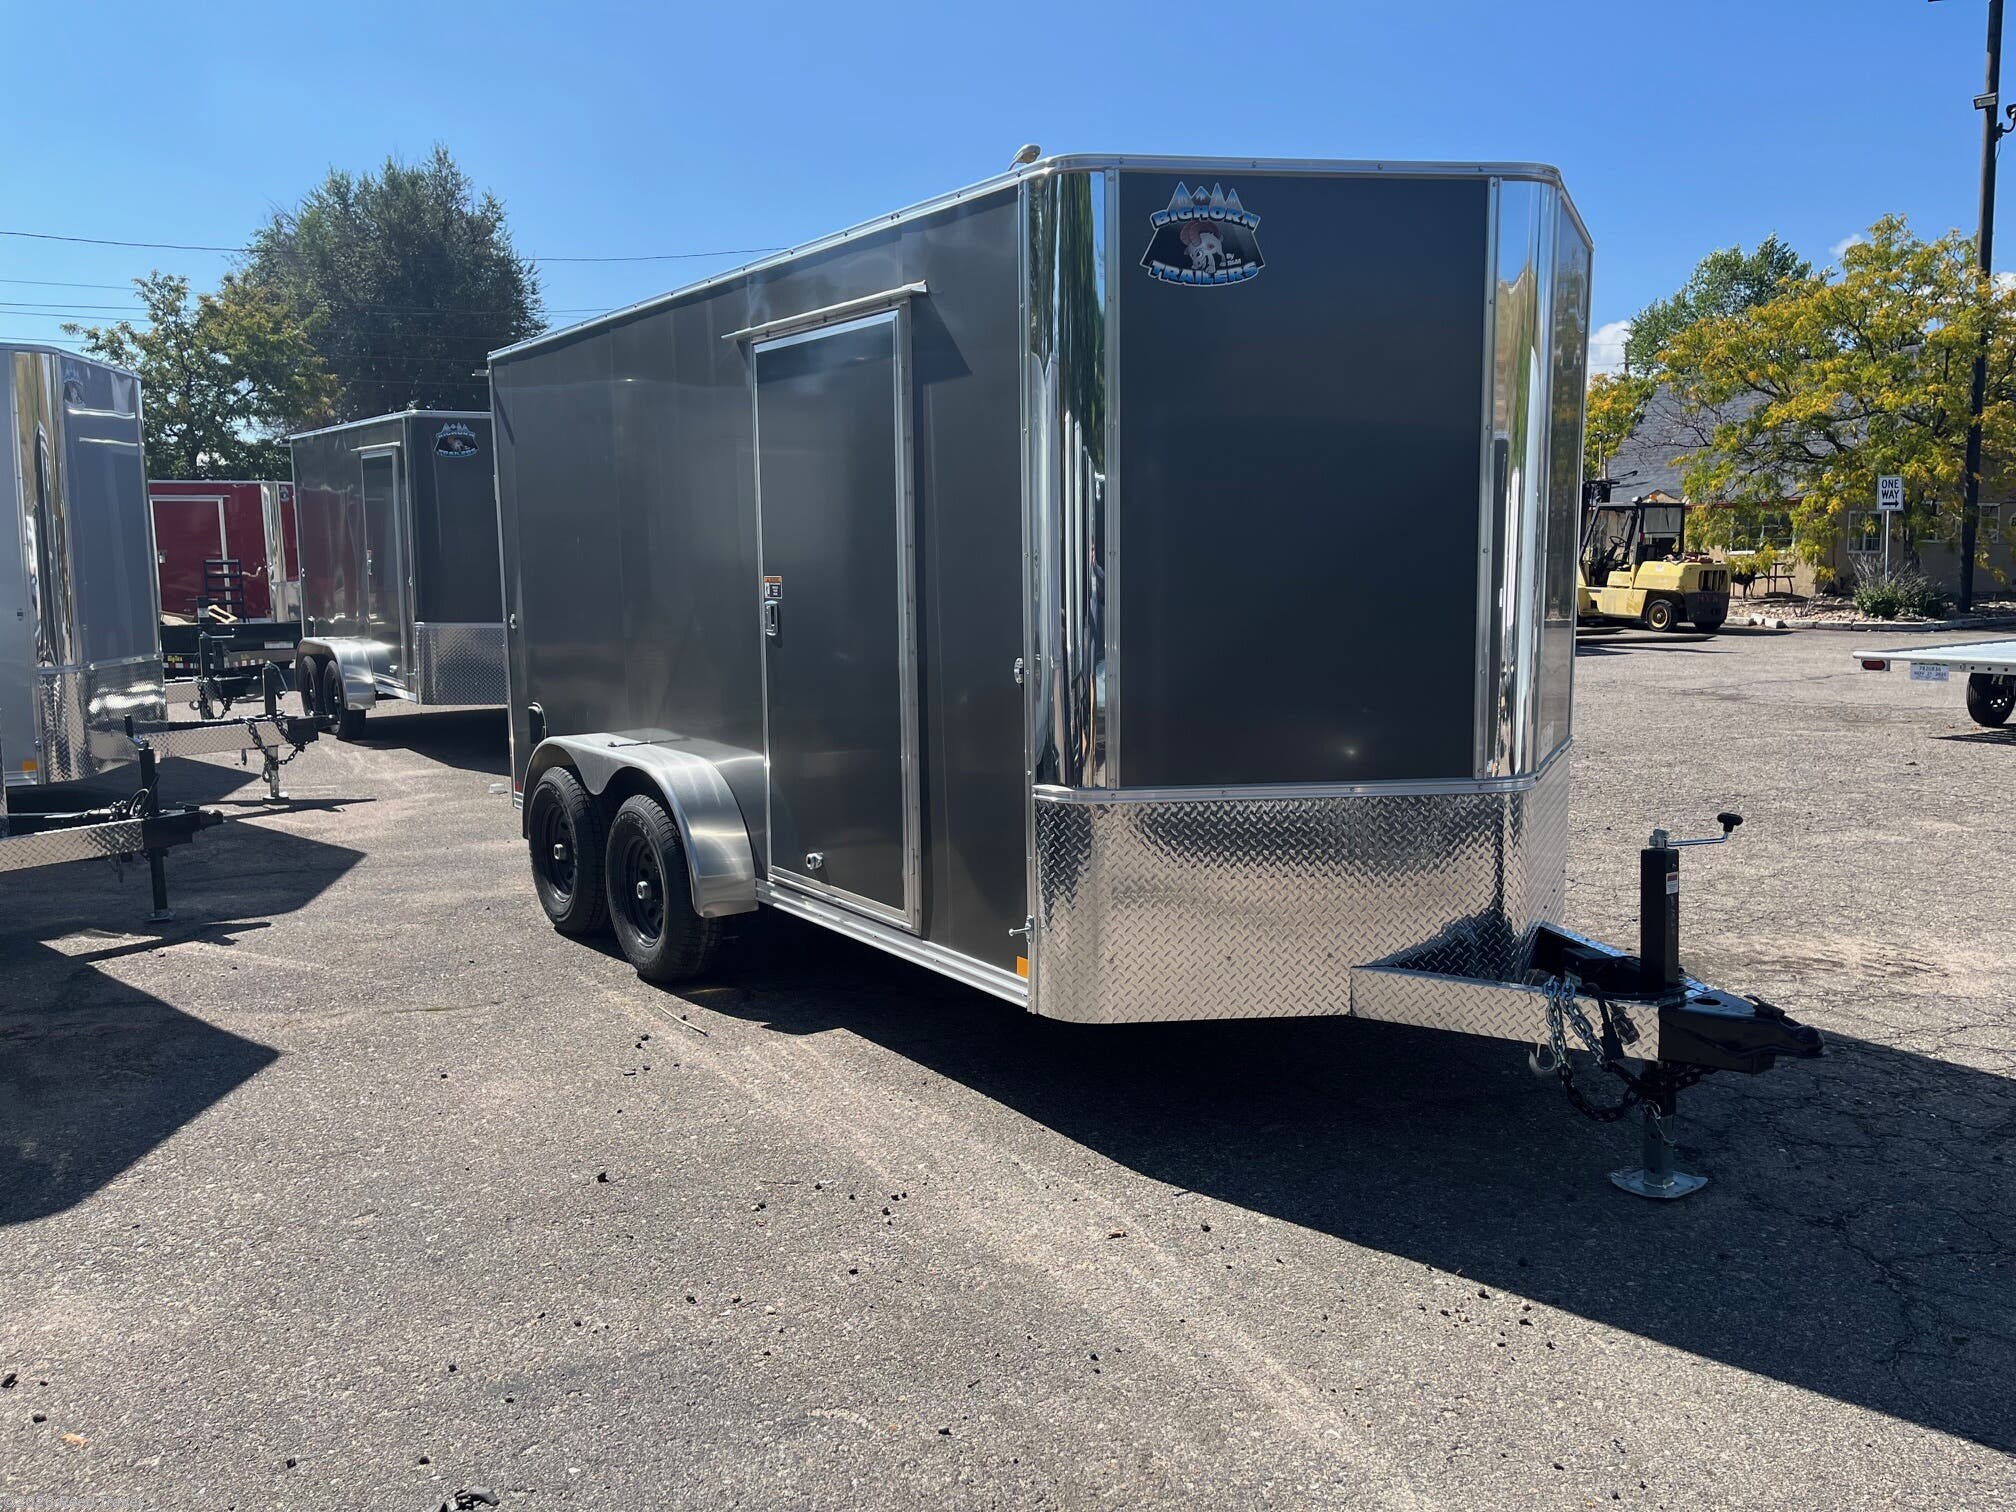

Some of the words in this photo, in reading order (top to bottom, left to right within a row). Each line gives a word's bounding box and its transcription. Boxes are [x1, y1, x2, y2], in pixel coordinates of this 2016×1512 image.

[1152, 205, 1260, 229] BIGHORN
[1151, 260, 1258, 284] TRAILERS
[1881, 479, 1899, 489] ONE
[1881, 489, 1900, 499] WAY
